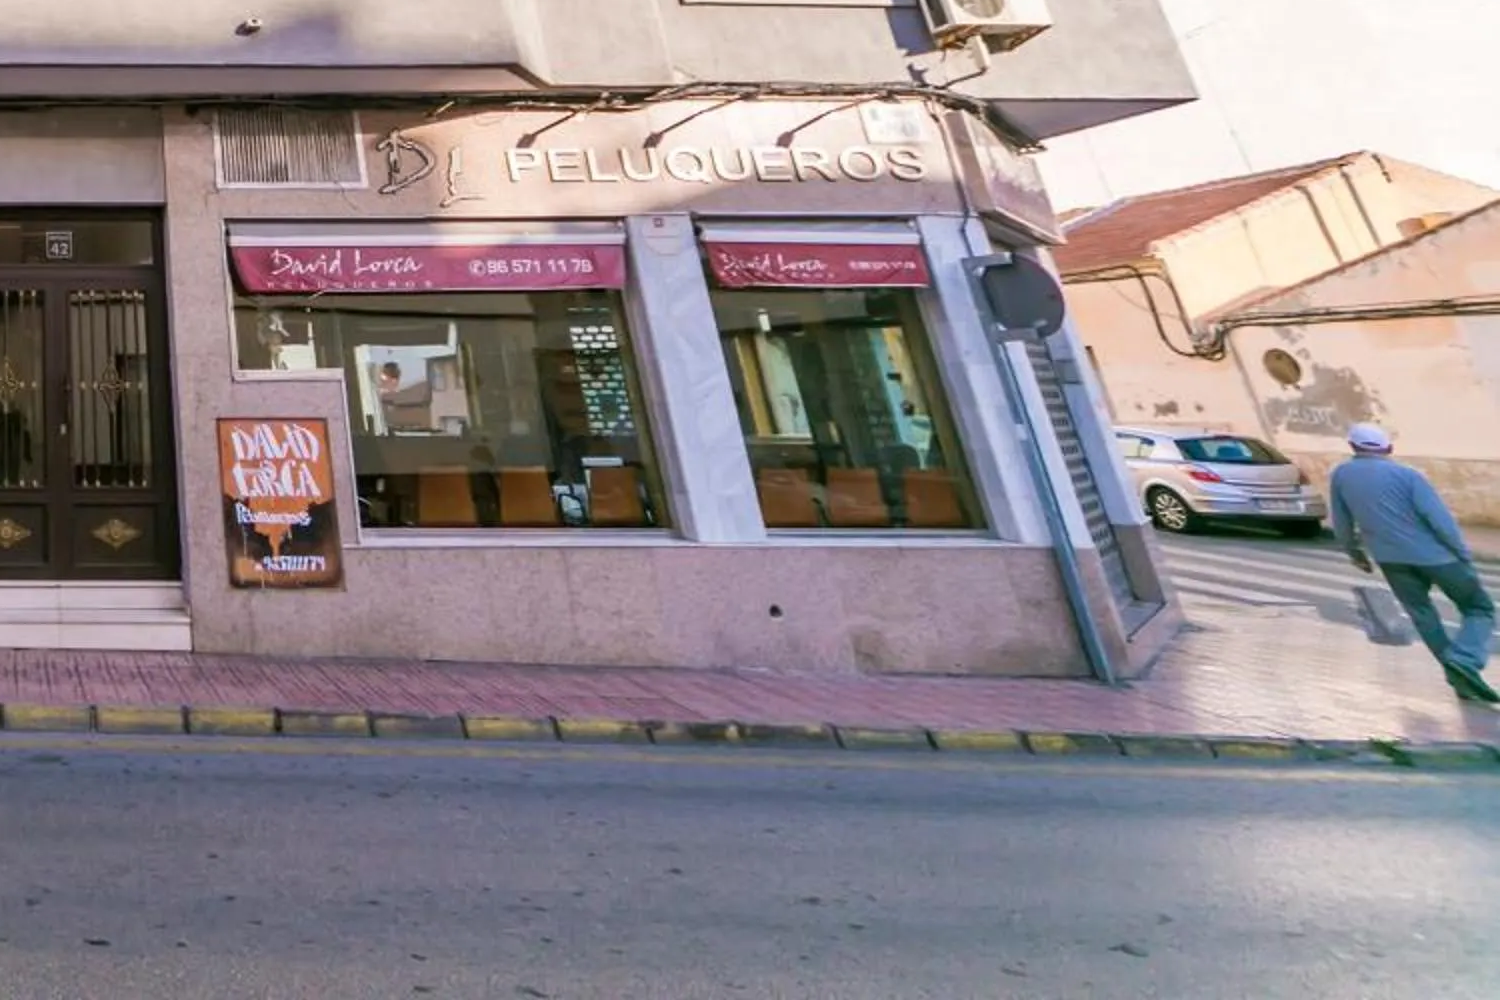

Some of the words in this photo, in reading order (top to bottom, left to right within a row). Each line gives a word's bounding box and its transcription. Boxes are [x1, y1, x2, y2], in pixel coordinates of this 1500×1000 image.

[504, 146, 928, 183] PELUQUEROS
[270, 248, 343, 276] David
[353, 248, 423, 276] Lorca
[513, 259, 541, 274] 571
[548, 259, 567, 273] 11
